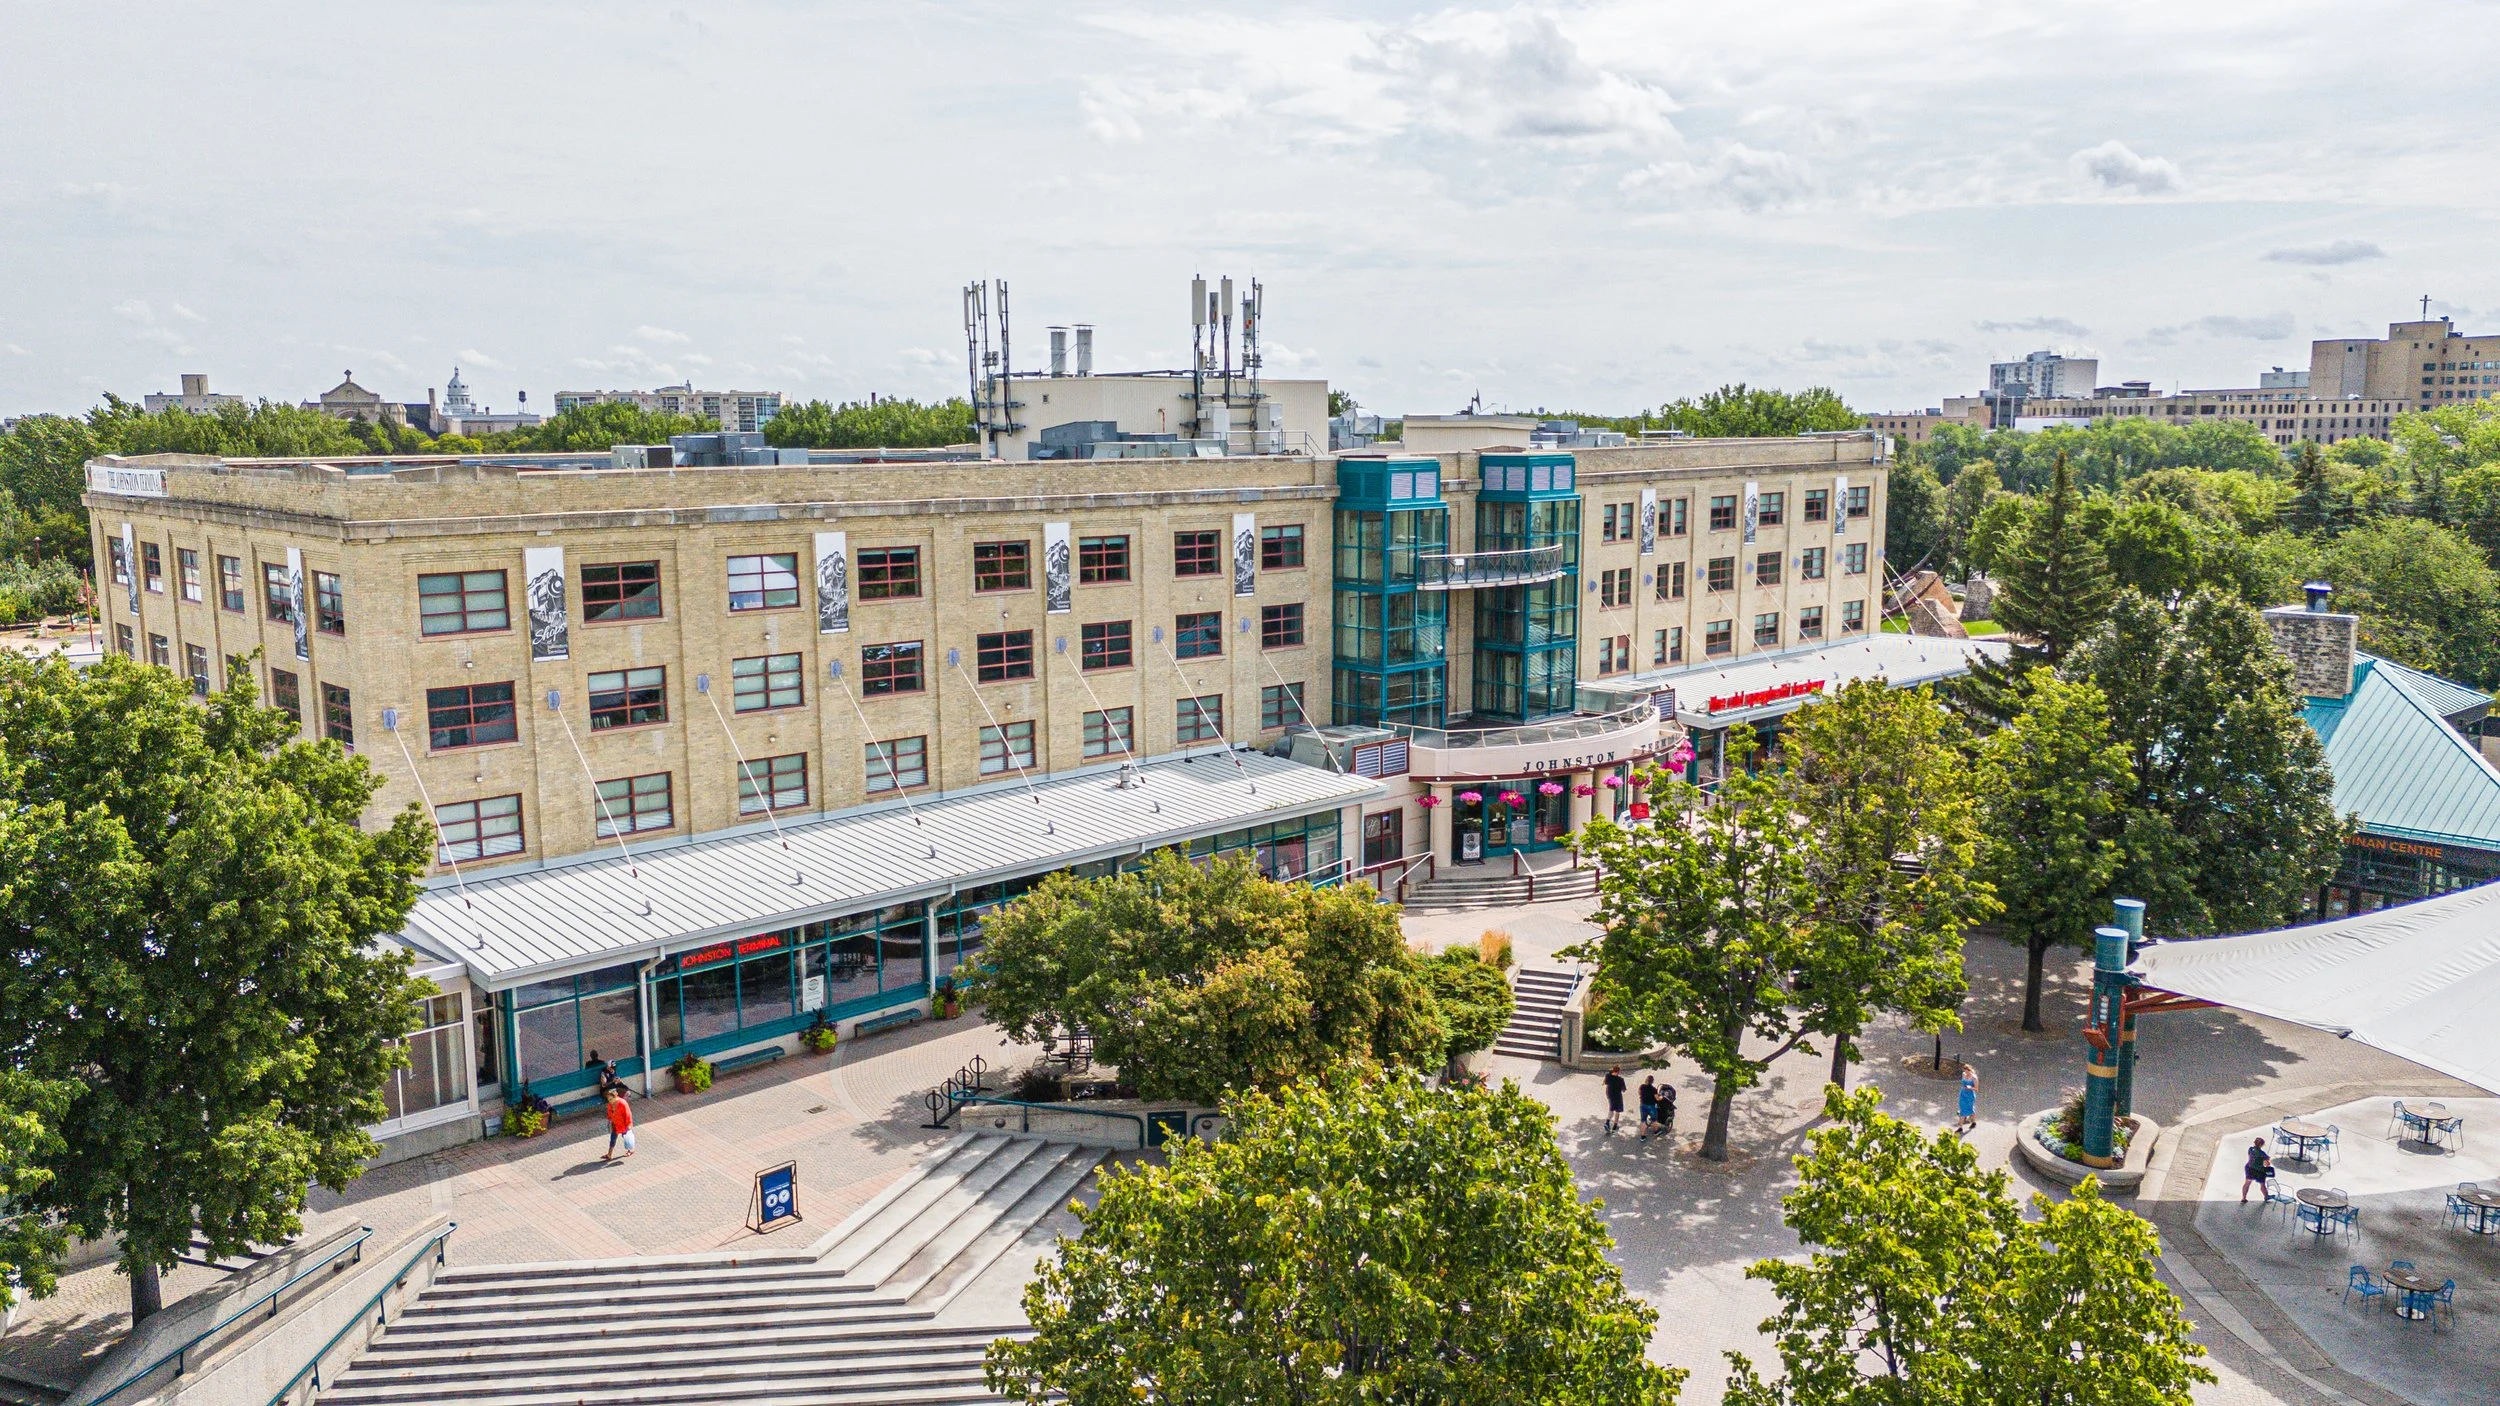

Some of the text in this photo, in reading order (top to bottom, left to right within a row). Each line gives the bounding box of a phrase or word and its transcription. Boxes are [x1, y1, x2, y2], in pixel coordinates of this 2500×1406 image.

[820, 599, 848, 619] Shops
[532, 623, 567, 645] Shops
[1523, 751, 1615, 771] JOHNSTON
[2389, 841, 2443, 858] CENTRE
[681, 948, 732, 967] JOHNSTON
[738, 936, 781, 954] TERMINAL
